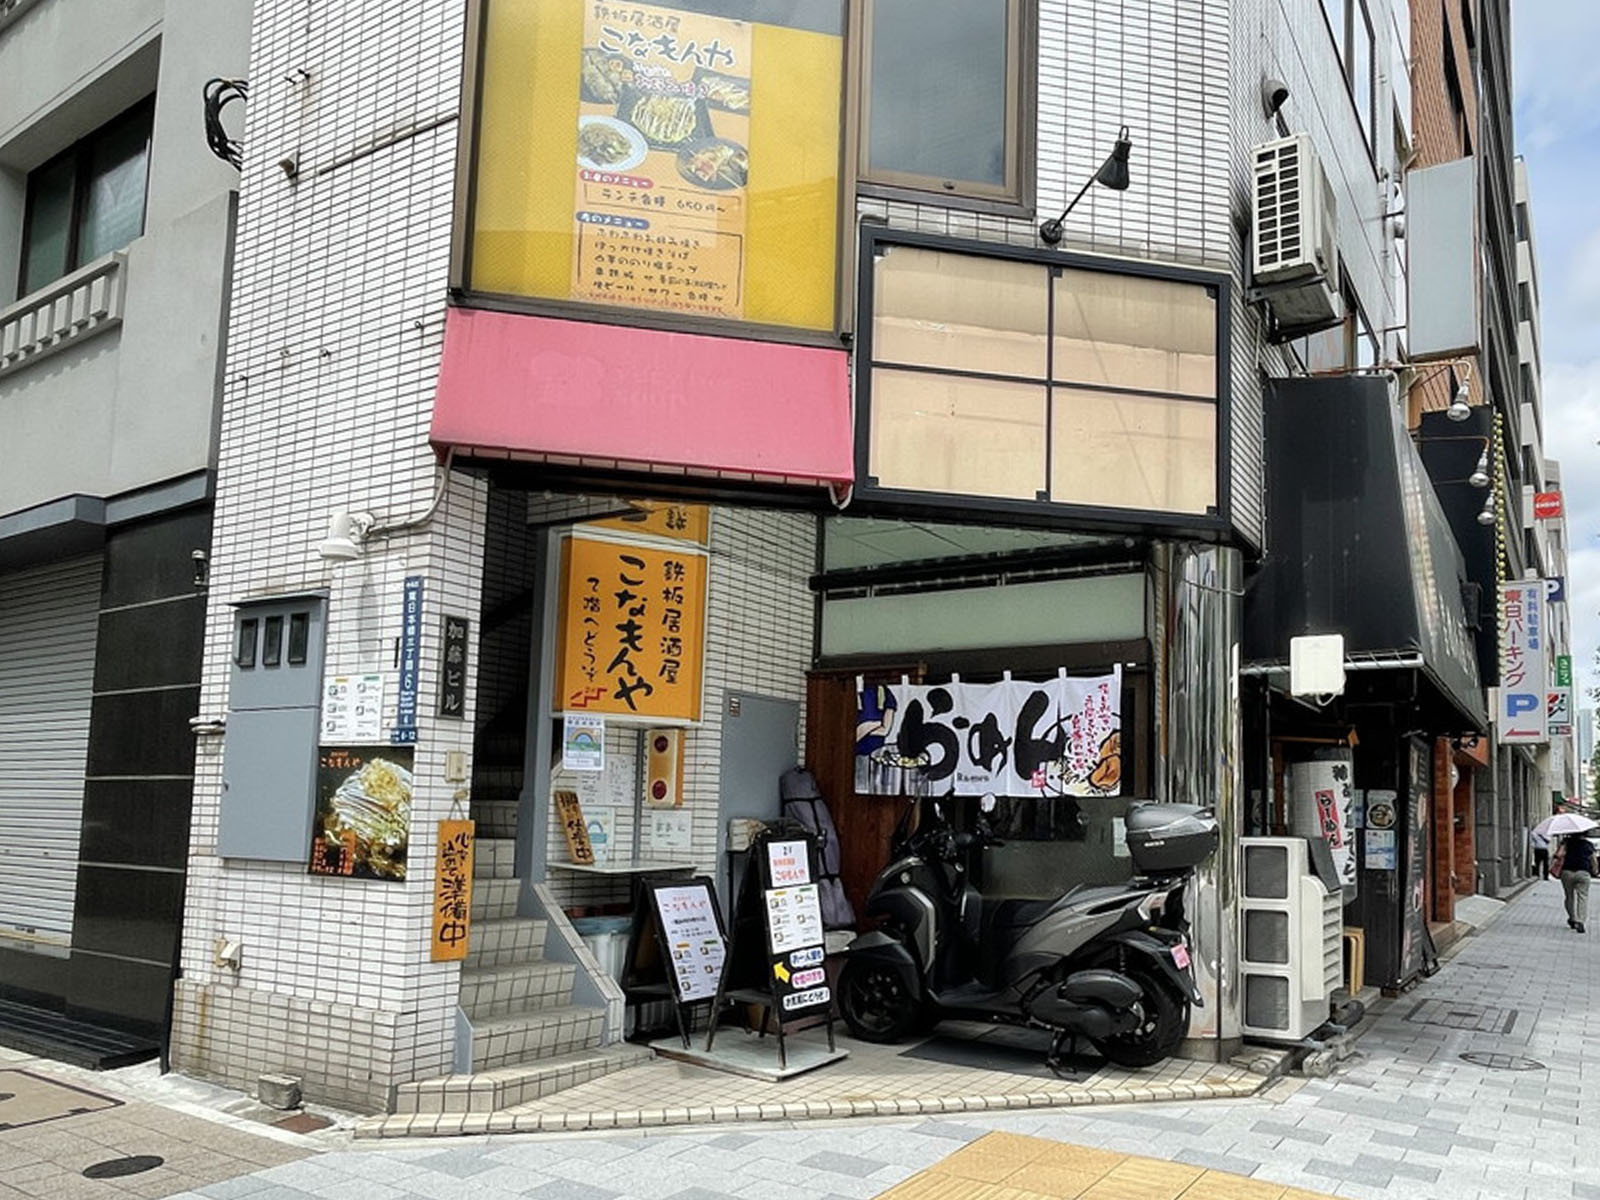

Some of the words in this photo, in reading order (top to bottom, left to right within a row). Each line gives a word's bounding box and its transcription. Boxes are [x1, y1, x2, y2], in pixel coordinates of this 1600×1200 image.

[600, 26, 735, 69] こなもんや
[607, 554, 654, 711] こなもんや
[659, 561, 686, 684] 鉄板居酒屋
[1504, 589, 1525, 688] 東日パーキング
[1527, 589, 1539, 650] 有料駐車場
[1507, 694, 1539, 717] P
